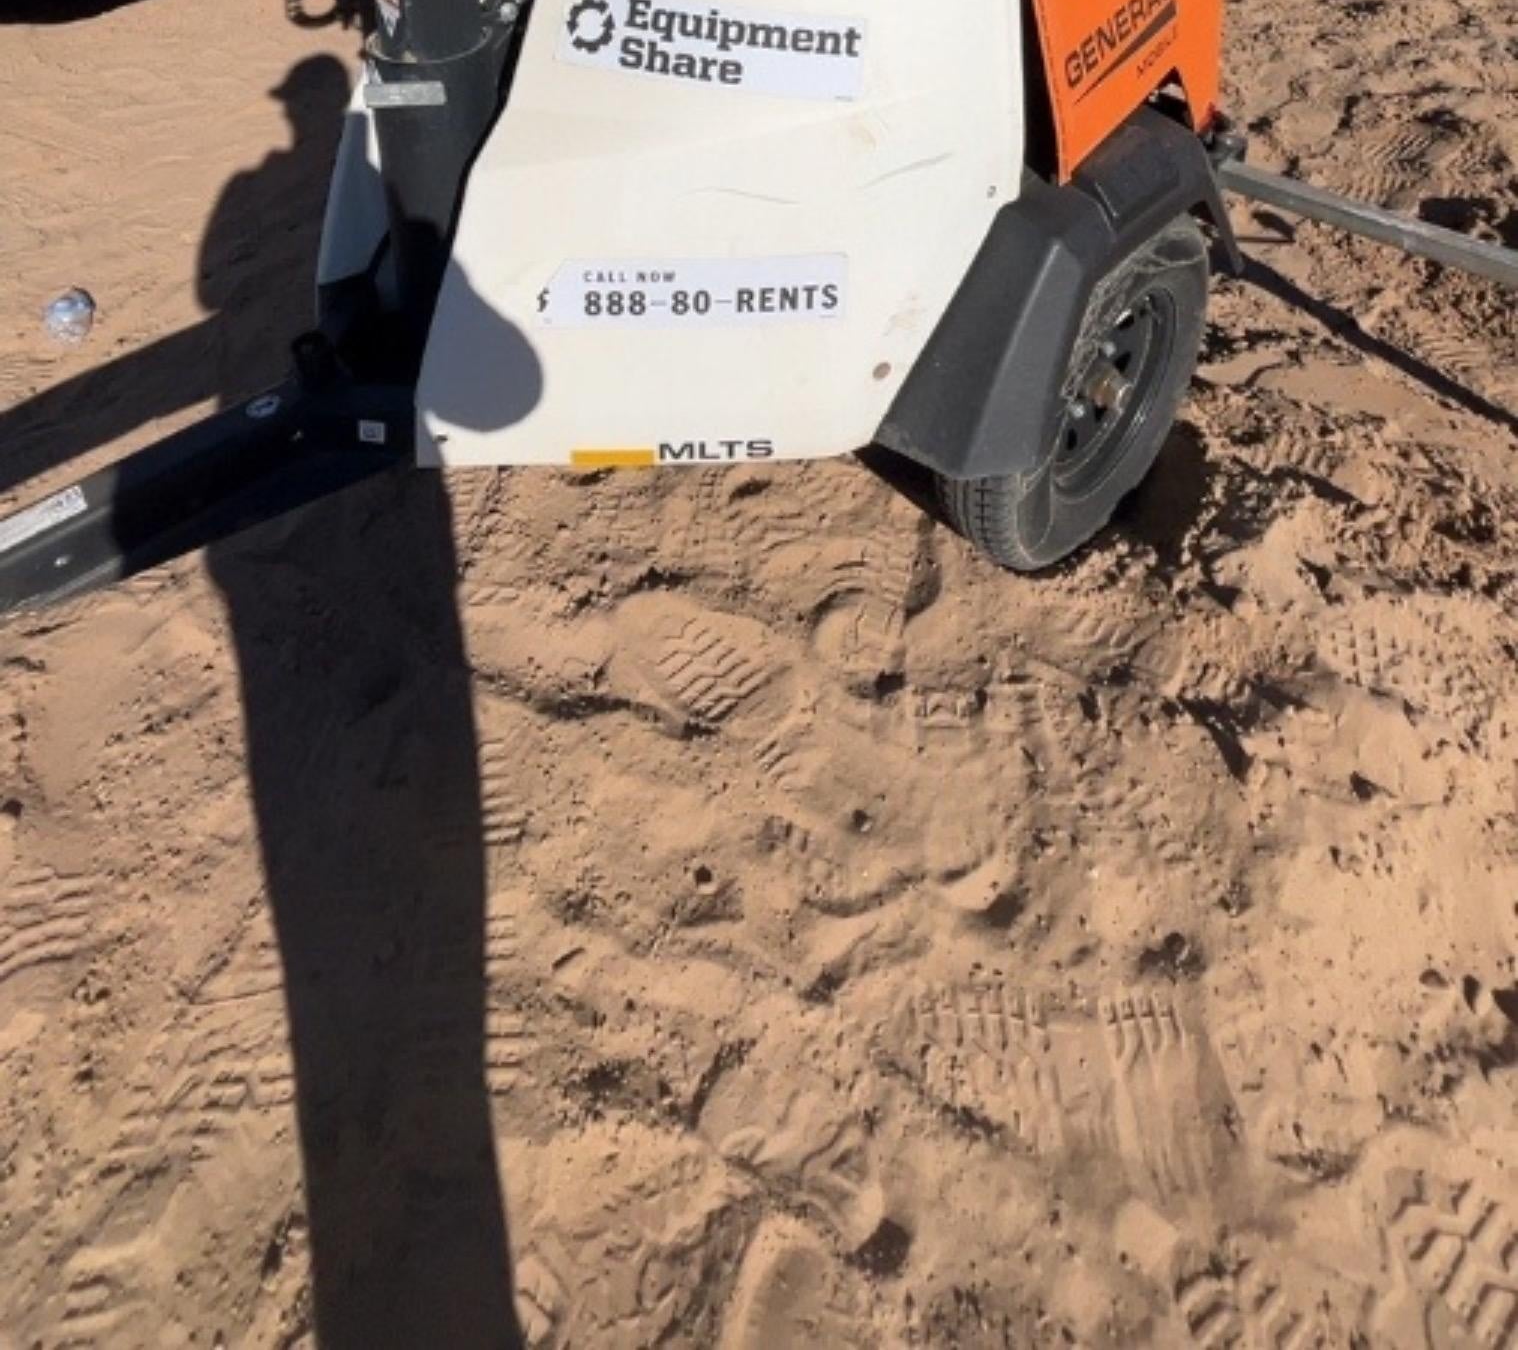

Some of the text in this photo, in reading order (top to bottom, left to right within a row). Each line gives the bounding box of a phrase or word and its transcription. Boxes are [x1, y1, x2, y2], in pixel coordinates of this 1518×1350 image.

[619, 38, 743, 84] Share
[583, 270, 676, 283] CALL NOW
[584, 284, 839, 316] 888-80-RENTS
[658, 440, 775, 461] MLTS
